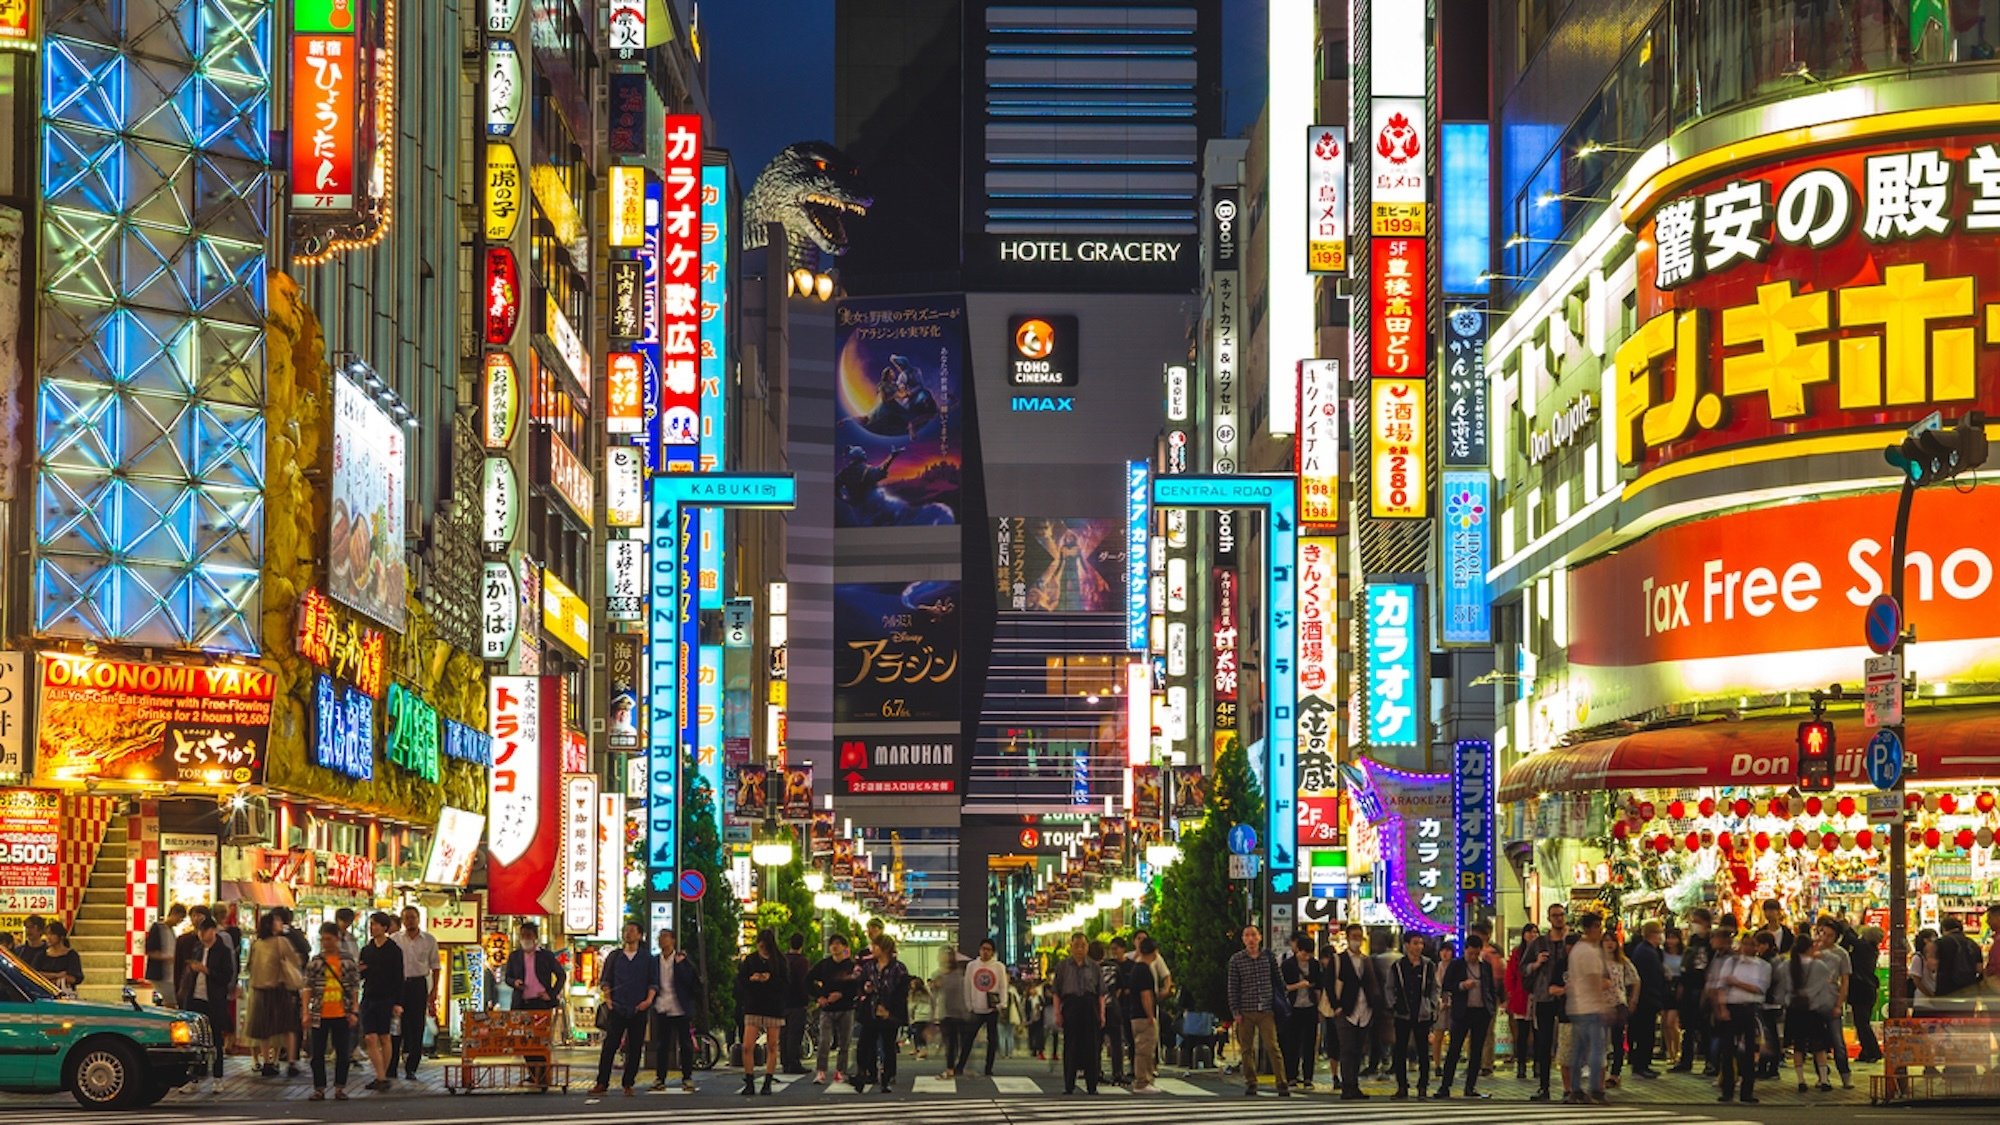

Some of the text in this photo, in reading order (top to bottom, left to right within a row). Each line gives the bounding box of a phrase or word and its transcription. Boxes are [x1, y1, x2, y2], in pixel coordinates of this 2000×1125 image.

[489, 16, 512, 29] 6F
[309, 41, 341, 55] 新宿
[307, 57, 342, 190] ひょうたん
[491, 170, 516, 218] 虎の子
[1377, 175, 1421, 189] 鳥メロ
[315, 196, 335, 207] 7F
[1318, 184, 1336, 236] 鳥メロ
[1377, 207, 1421, 217] 生ビール
[1214, 200, 1236, 259] Booth
[1382, 219, 1413, 232] 199
[1000, 242, 1181, 262] HOTEL GRACERY
[1312, 242, 1342, 251] 生ビール
[1316, 251, 1342, 264] 199
[1390, 241, 1408, 256] 5F
[664, 126, 698, 394] カラオケ歌広場
[1384, 259, 1413, 373] 豊後高田どり
[1219, 278, 1232, 416] ネットカフェ & カプセル
[1015, 361, 1050, 373] TOHO
[1015, 372, 1063, 383] CINEMAS
[1325, 362, 1337, 371] 4F
[701, 185, 719, 591] カラオケ&パーテー館
[1450, 339, 1471, 458] かんかん商店
[1012, 397, 1074, 411] IMAX
[1385, 401, 1414, 442] 酒場
[1530, 391, 1591, 466] Don Quijote
[1160, 485, 1273, 496] CENTRAL ROAD
[1305, 484, 1329, 496] 198
[1390, 456, 1407, 507] 280
[1305, 507, 1328, 517] 198
[1217, 510, 1235, 553] ooth
[489, 542, 505, 553] 1F
[1468, 532, 1481, 577] IDOL
[1454, 532, 1467, 589] STAGE
[1131, 529, 1148, 644] カラオケランド
[1642, 576, 1691, 637] Tax
[1703, 558, 1822, 623] Free
[1301, 544, 1323, 663] きんくら酒場
[488, 641, 505, 652] B1
[889, 631, 925, 644] Disney
[613, 642, 633, 691] 海の家
[837, 638, 958, 689] アラジン
[1214, 627, 1238, 693] 甘太郎
[1374, 589, 1412, 738] カラオケ
[48, 660, 273, 696] OKONOMI YAKI
[653, 536, 674, 833] GODZILLA ROAD
[1274, 564, 1292, 813] ゴジラロード
[137, 707, 269, 726] Drinks for 2 hours ¥2,500
[138, 694, 174, 708] dinner
[177, 696, 200, 709] with
[201, 697, 270, 714] Free-Flowing
[1216, 701, 1236, 714] 4F
[1216, 717, 1236, 727] 3F
[494, 686, 519, 793] トラノコ
[1297, 693, 1336, 792] 金の蔵
[874, 744, 953, 766] MARUHAN
[1730, 752, 1790, 777] Don
[1874, 744, 1887, 781] P
[1883, 764, 1894, 780] 40
[177, 768, 249, 781] TORAYU 2F
[1384, 796, 1434, 804] KARAOKE
[1460, 750, 1486, 866] カラオケ
[1297, 801, 1338, 840] 2F /3F
[1042, 831, 1085, 847] TOHO
[1418, 818, 1443, 913] カラオケ
[571, 879, 590, 899] 集
[1460, 872, 1486, 890] B1
[432, 917, 474, 928] トラノコ
